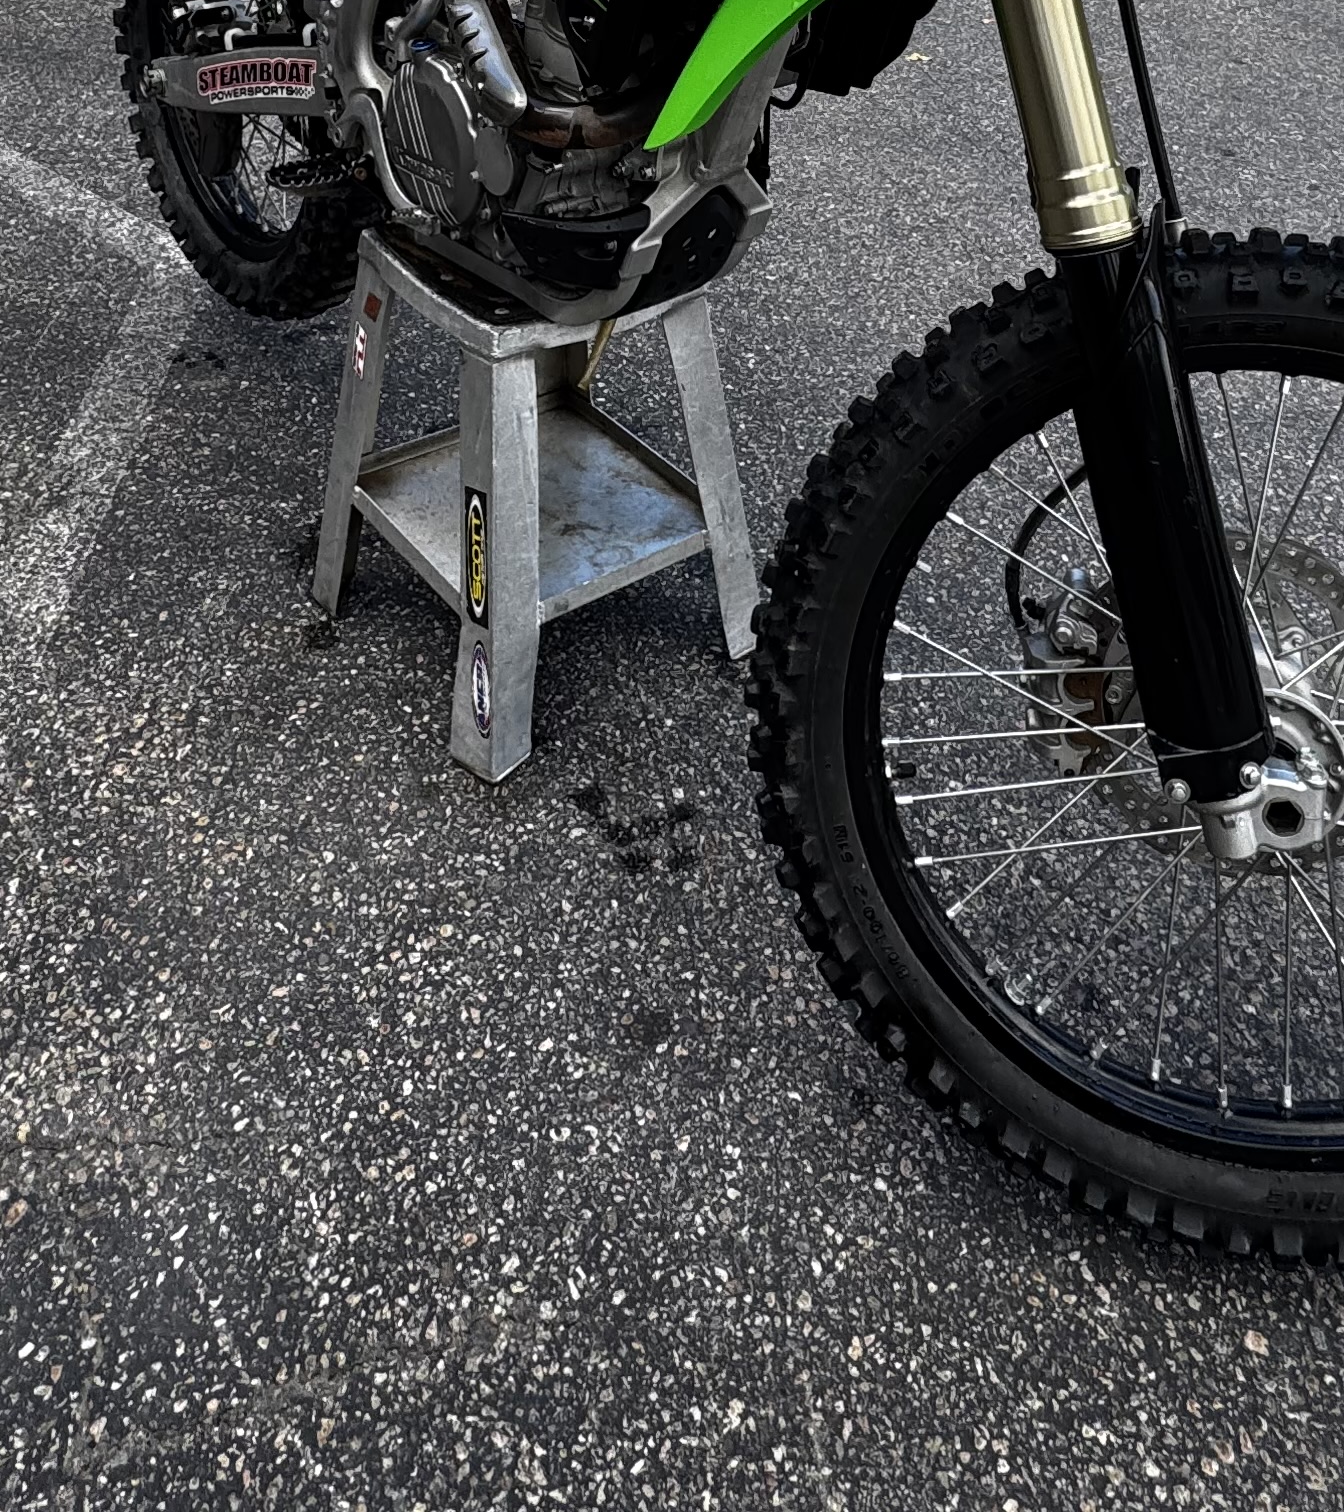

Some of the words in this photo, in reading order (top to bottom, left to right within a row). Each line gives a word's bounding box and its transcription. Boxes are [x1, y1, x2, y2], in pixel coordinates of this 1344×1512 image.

[198, 61, 313, 91] STEAMBOAT
[210, 85, 295, 102] POWERSPORTS
[471, 513, 482, 602] SCOTT
